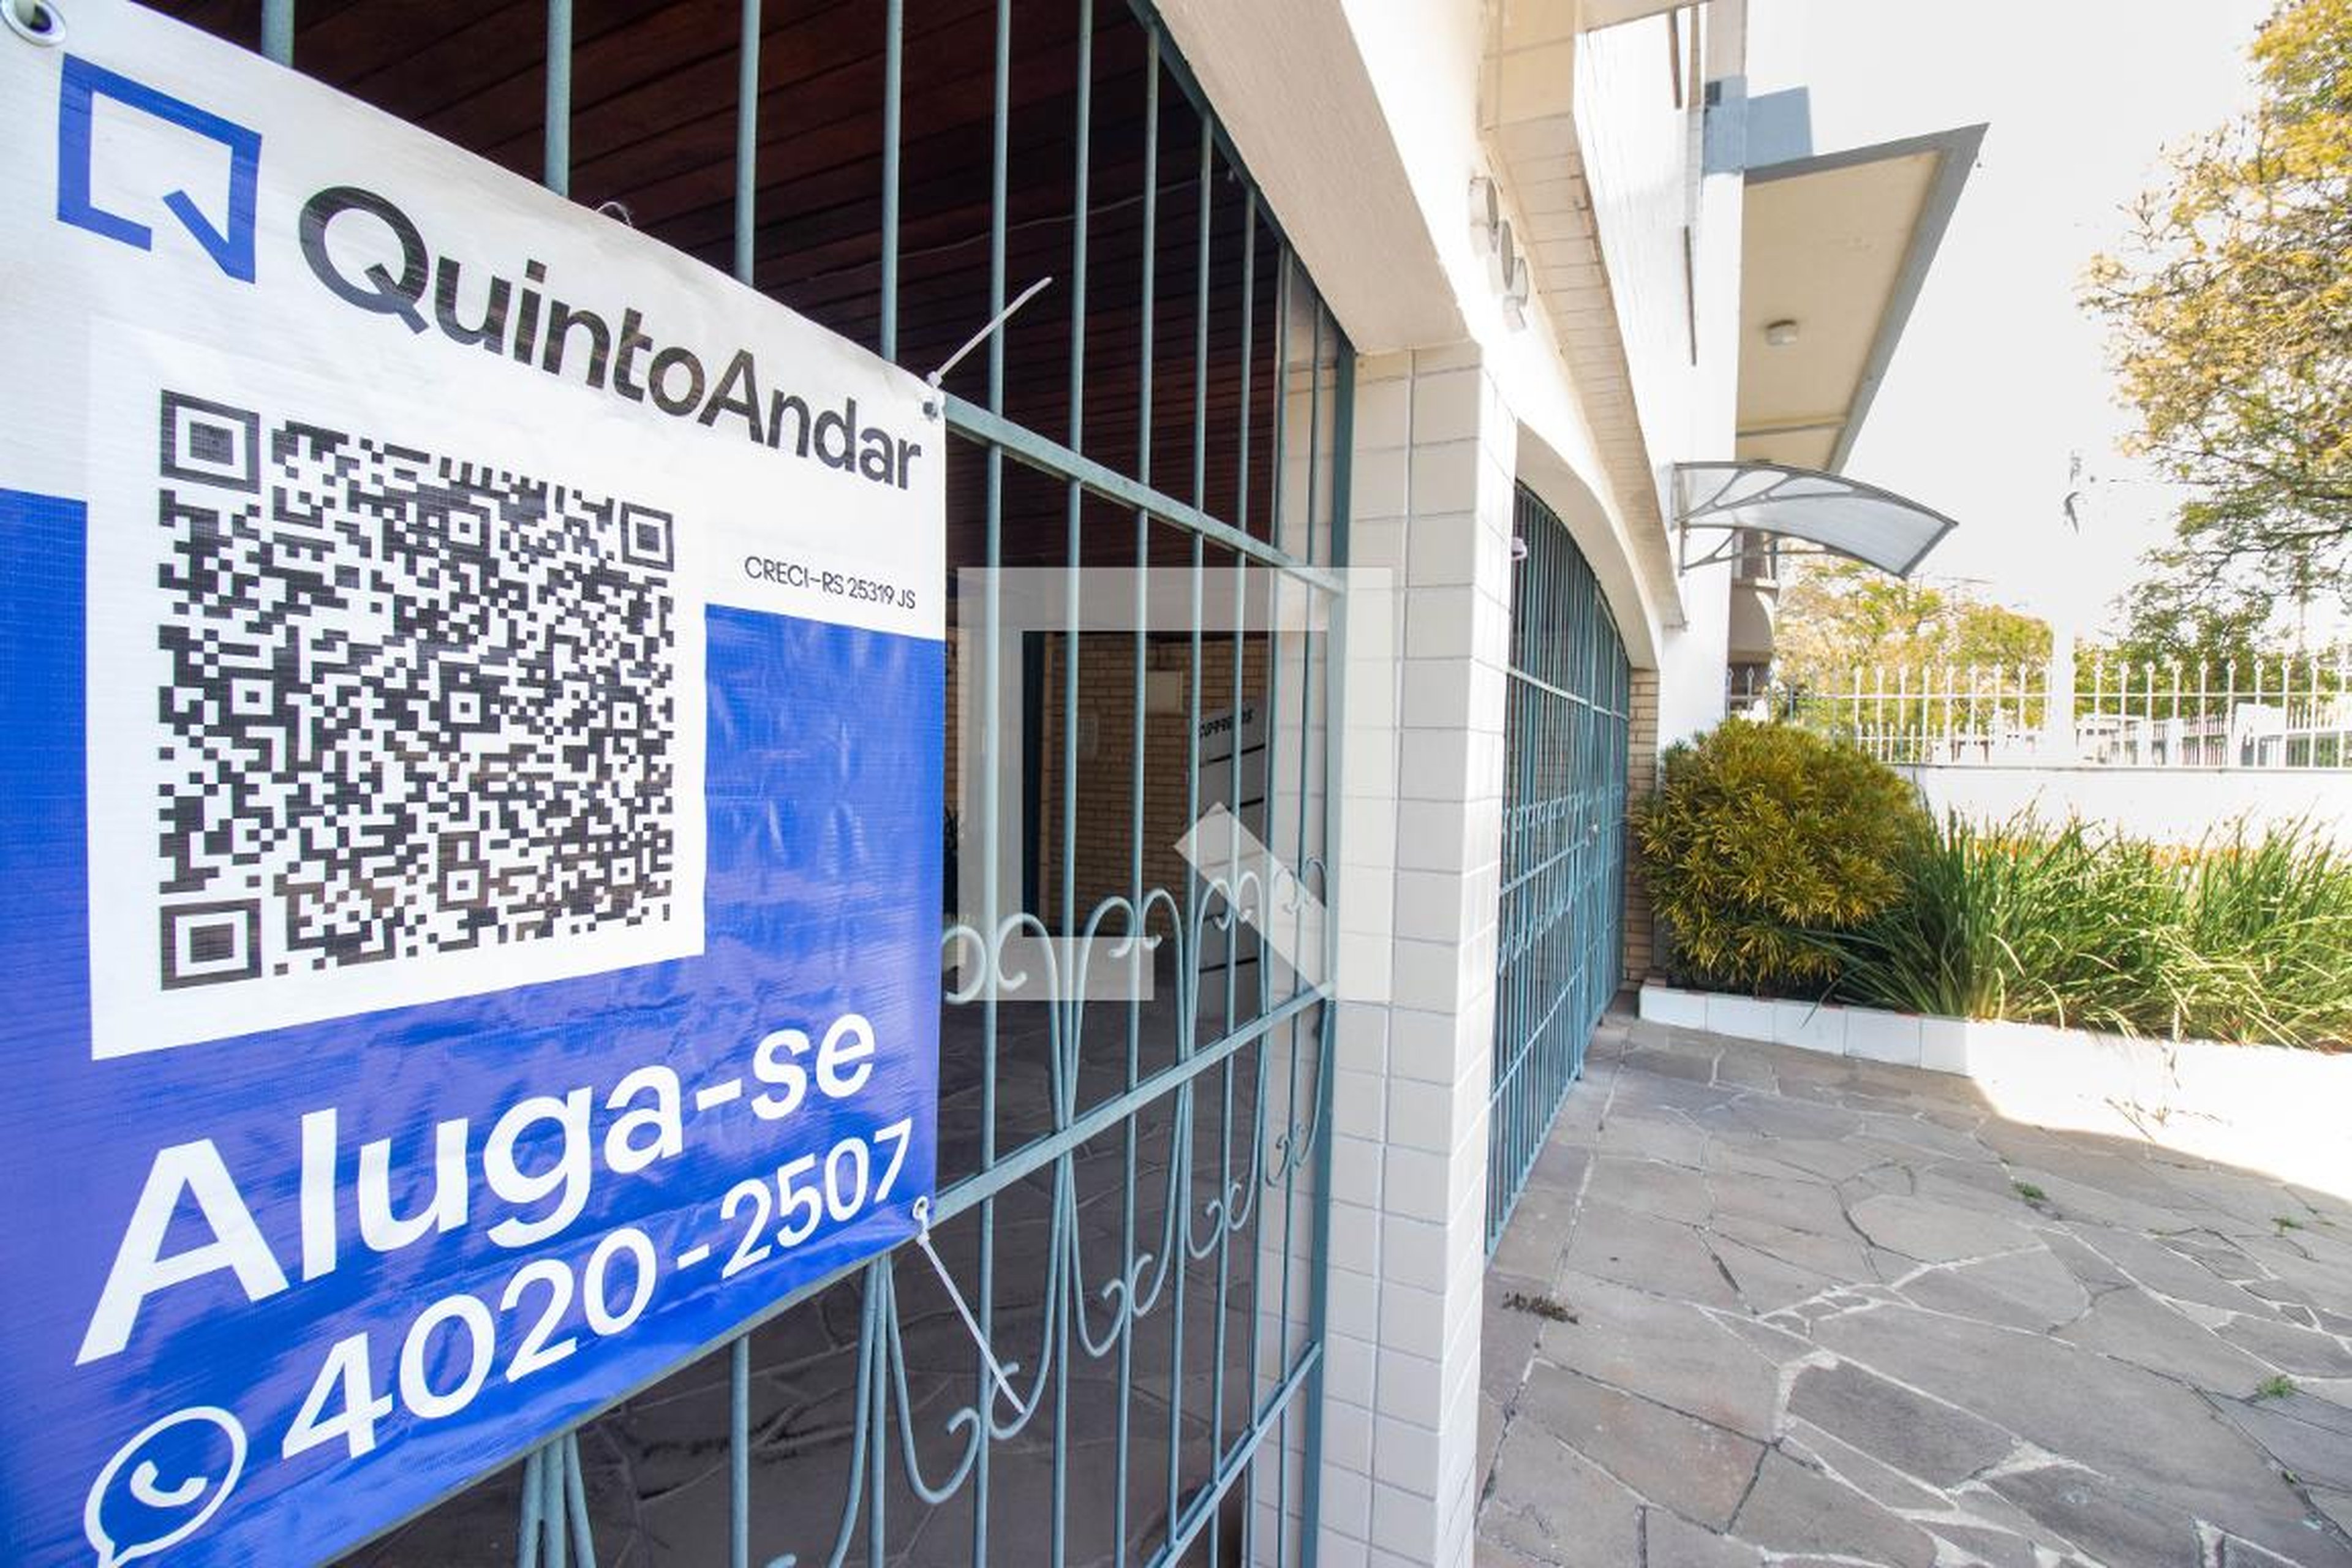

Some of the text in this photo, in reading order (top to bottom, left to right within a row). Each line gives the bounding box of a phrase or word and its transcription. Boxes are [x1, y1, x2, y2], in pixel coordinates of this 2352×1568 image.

[298, 185, 921, 489] QuintoAndar
[744, 556, 916, 610] CRECI-RS 25319 JS
[75, 1012, 876, 1366] Aluga-se
[281, 1118, 913, 1462] 4020-2507
